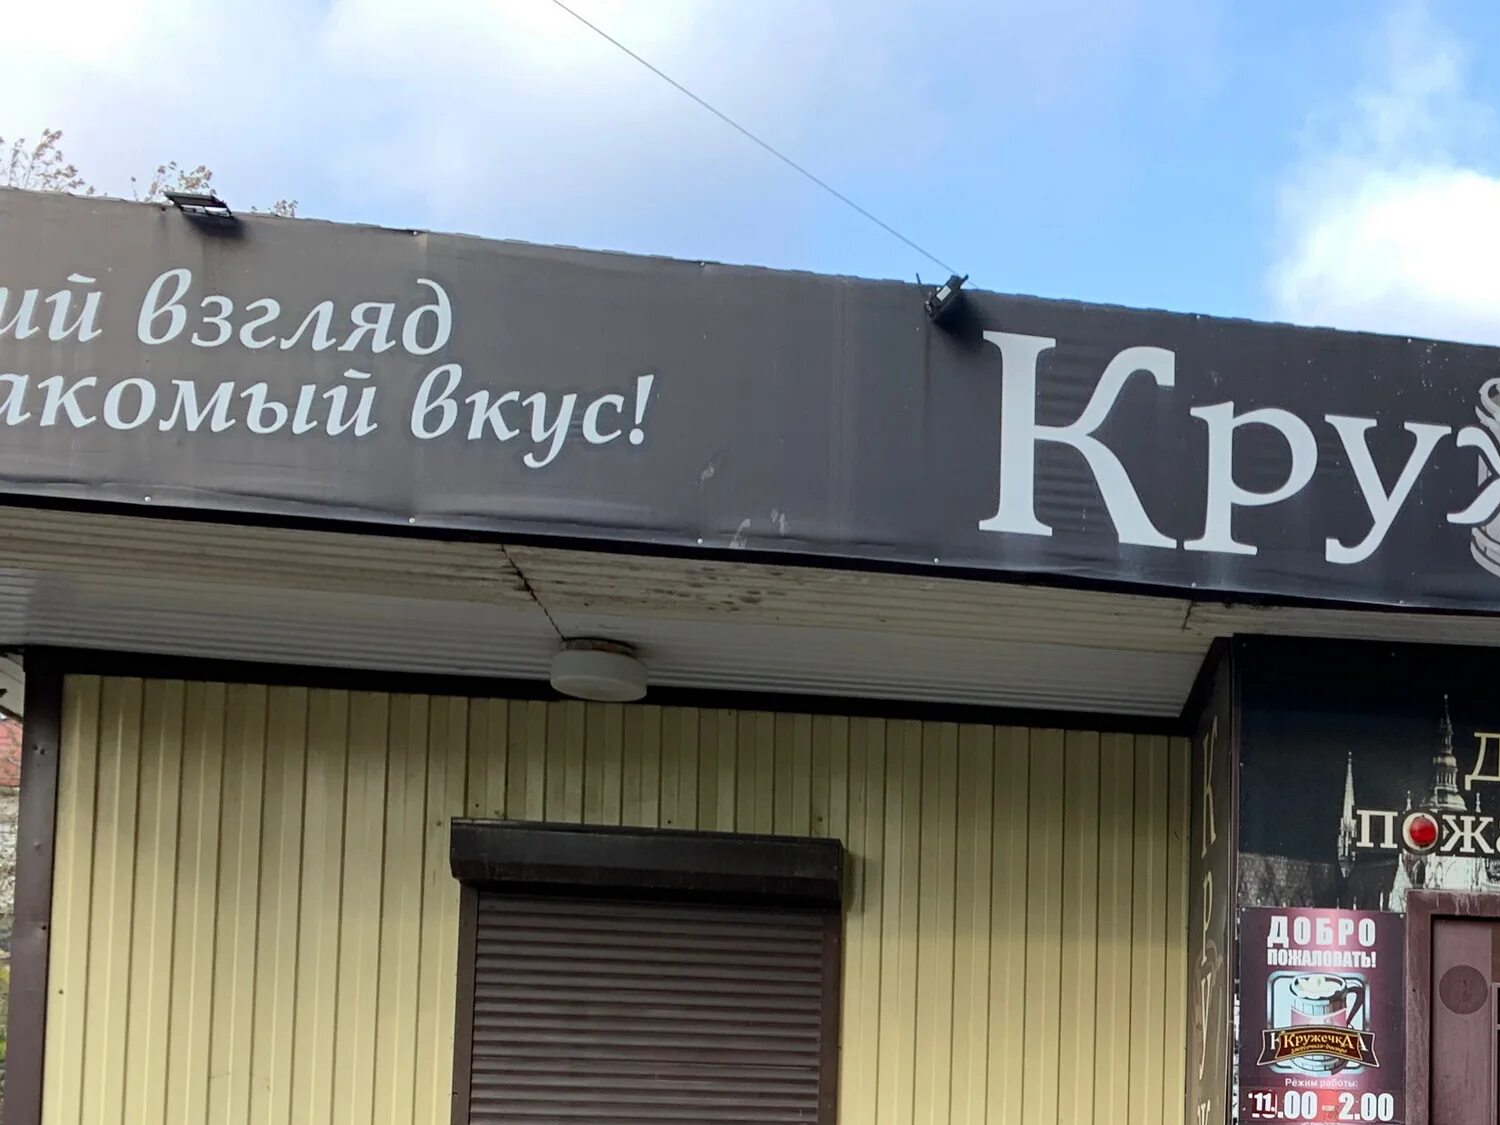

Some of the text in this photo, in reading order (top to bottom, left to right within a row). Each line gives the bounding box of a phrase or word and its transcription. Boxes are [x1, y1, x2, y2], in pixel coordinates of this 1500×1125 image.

[137, 267, 452, 356] взгляд
[0, 362, 654, 469] акомый вкус!
[1267, 915, 1376, 948] ДОБРО
[1267, 949, 1377, 968] ПОЖАЛОВАТЬ!
[1285, 1078, 1358, 1089] Режим работы:
[1338, 1092, 1395, 1121] 2.00
